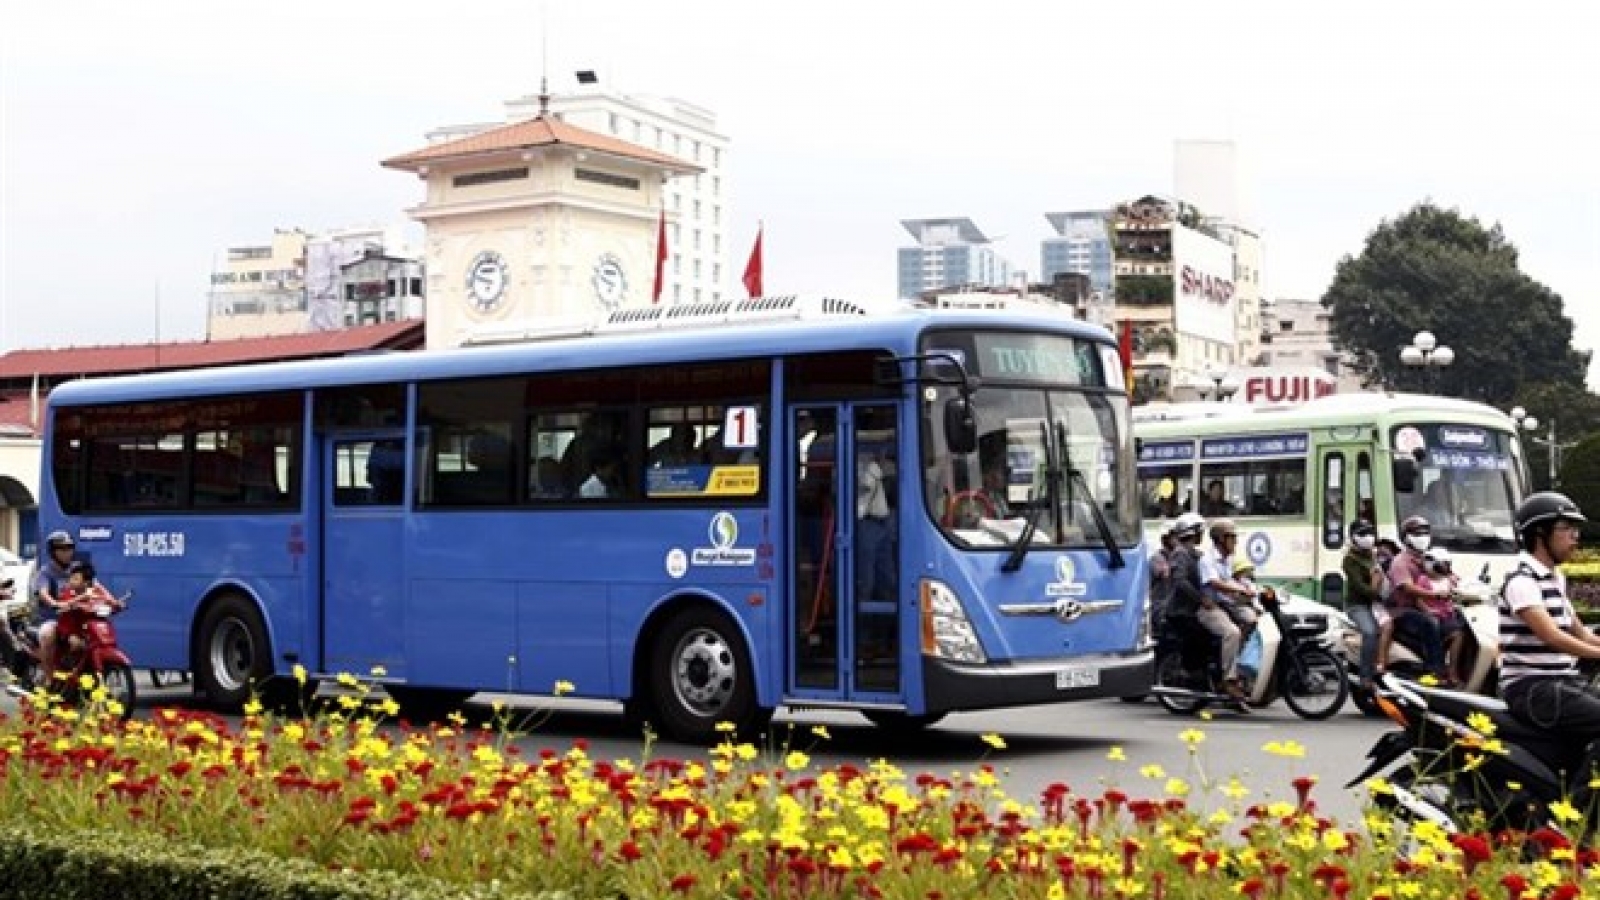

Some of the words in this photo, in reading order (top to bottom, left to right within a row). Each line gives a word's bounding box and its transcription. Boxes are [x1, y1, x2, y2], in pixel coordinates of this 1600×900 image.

[1181, 264, 1235, 306] SHARP
[1245, 376, 1309, 403] FUJI
[733, 408, 745, 446] 1
